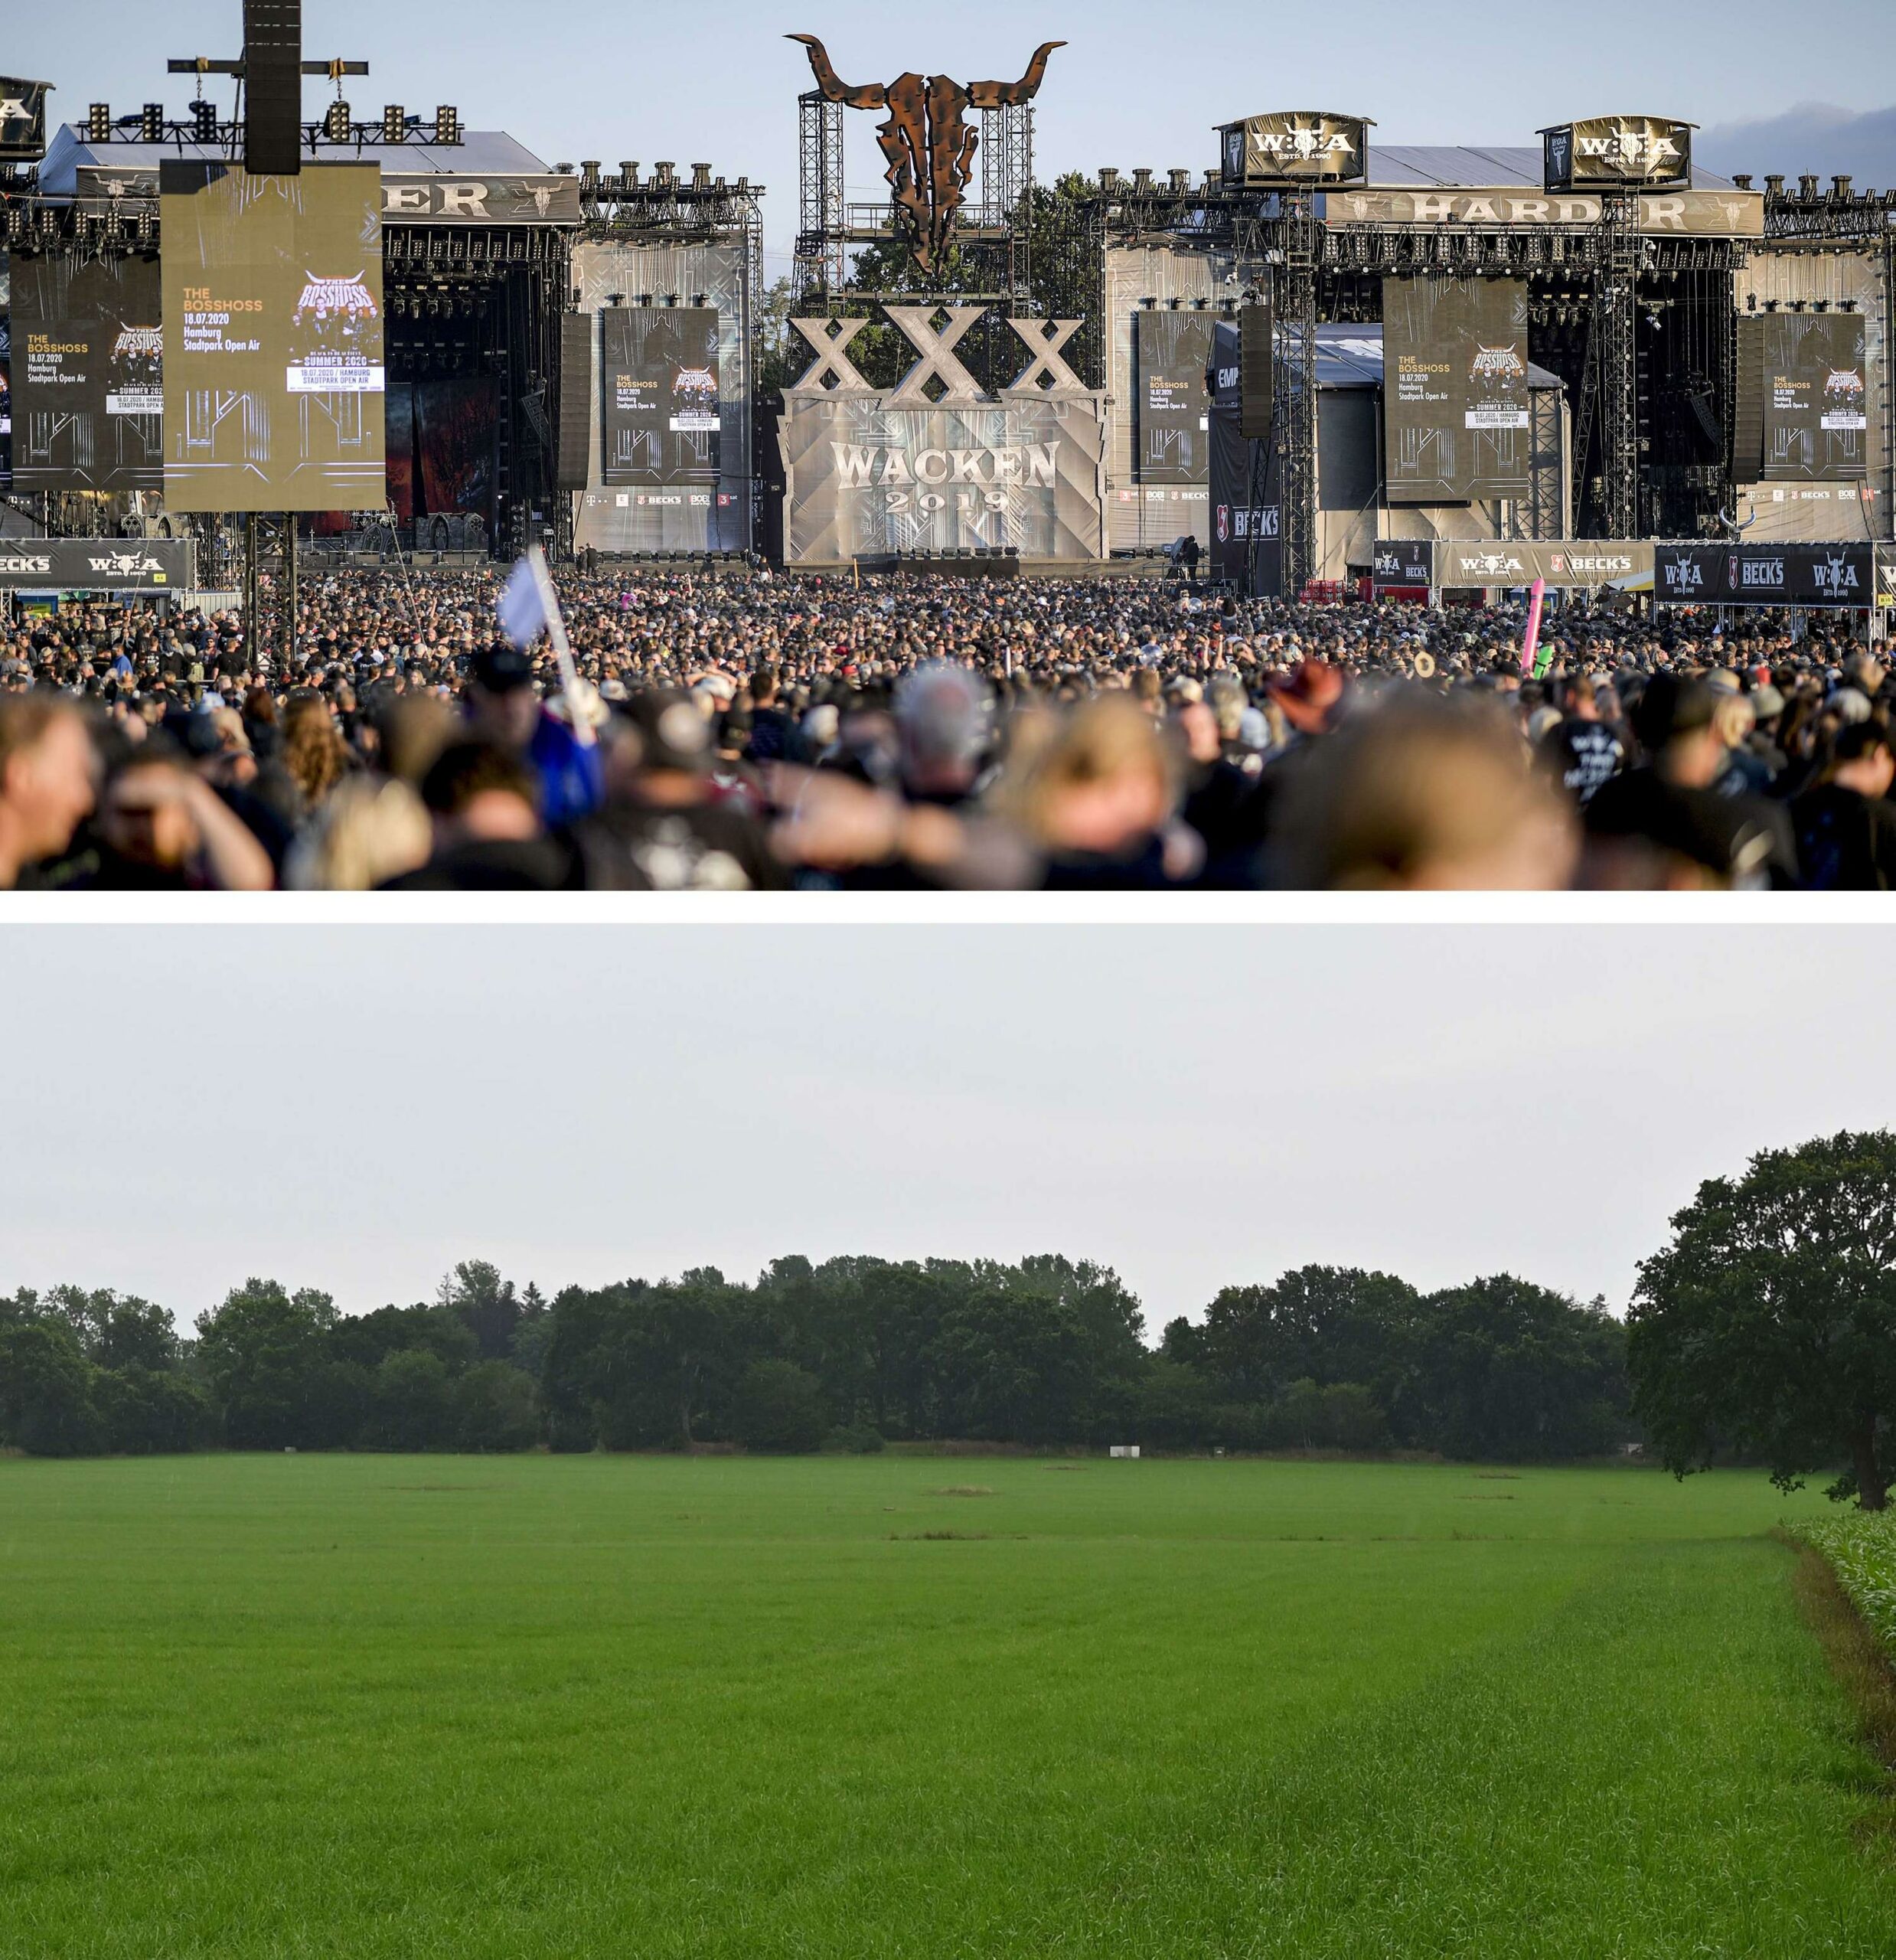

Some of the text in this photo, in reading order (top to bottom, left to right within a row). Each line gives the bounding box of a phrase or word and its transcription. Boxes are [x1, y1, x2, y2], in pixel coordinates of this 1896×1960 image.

[1407, 192, 1689, 230] HARDR
[184, 288, 210, 299] THE
[298, 285, 374, 307] BOSSHOSS
[184, 299, 263, 312] BOSSHOSS
[184, 312, 230, 325] 18.07.2020
[184, 325, 221, 340] Hamburg
[28, 335, 48, 344] THE
[28, 344, 88, 353] BOSSHOSS
[184, 338, 260, 353] Stadtpark Open Air
[28, 354, 63, 363] 18.07.2020
[304, 356, 367, 367] SUMMER 2020
[1398, 356, 1416, 364] THE
[1473, 353, 1522, 369] BOSSHOSS
[28, 364, 57, 374] Hamburg
[1398, 364, 1451, 373] BOSSHOSS
[28, 374, 86, 384] Stadtpark Open Air
[1398, 374, 1428, 382] 18.07.2020
[119, 387, 148, 395] SUMMER
[1398, 383, 1423, 392] Hamburg
[1398, 391, 1424, 401] Stadtpark
[1425, 392, 1439, 401] Open
[830, 441, 1061, 490] WACKEN
[885, 491, 1009, 514] 2019
[1571, 557, 1632, 570] BECK'S
[1405, 566, 1428, 577] BECK'S
[1742, 560, 1784, 584] BECK'S
